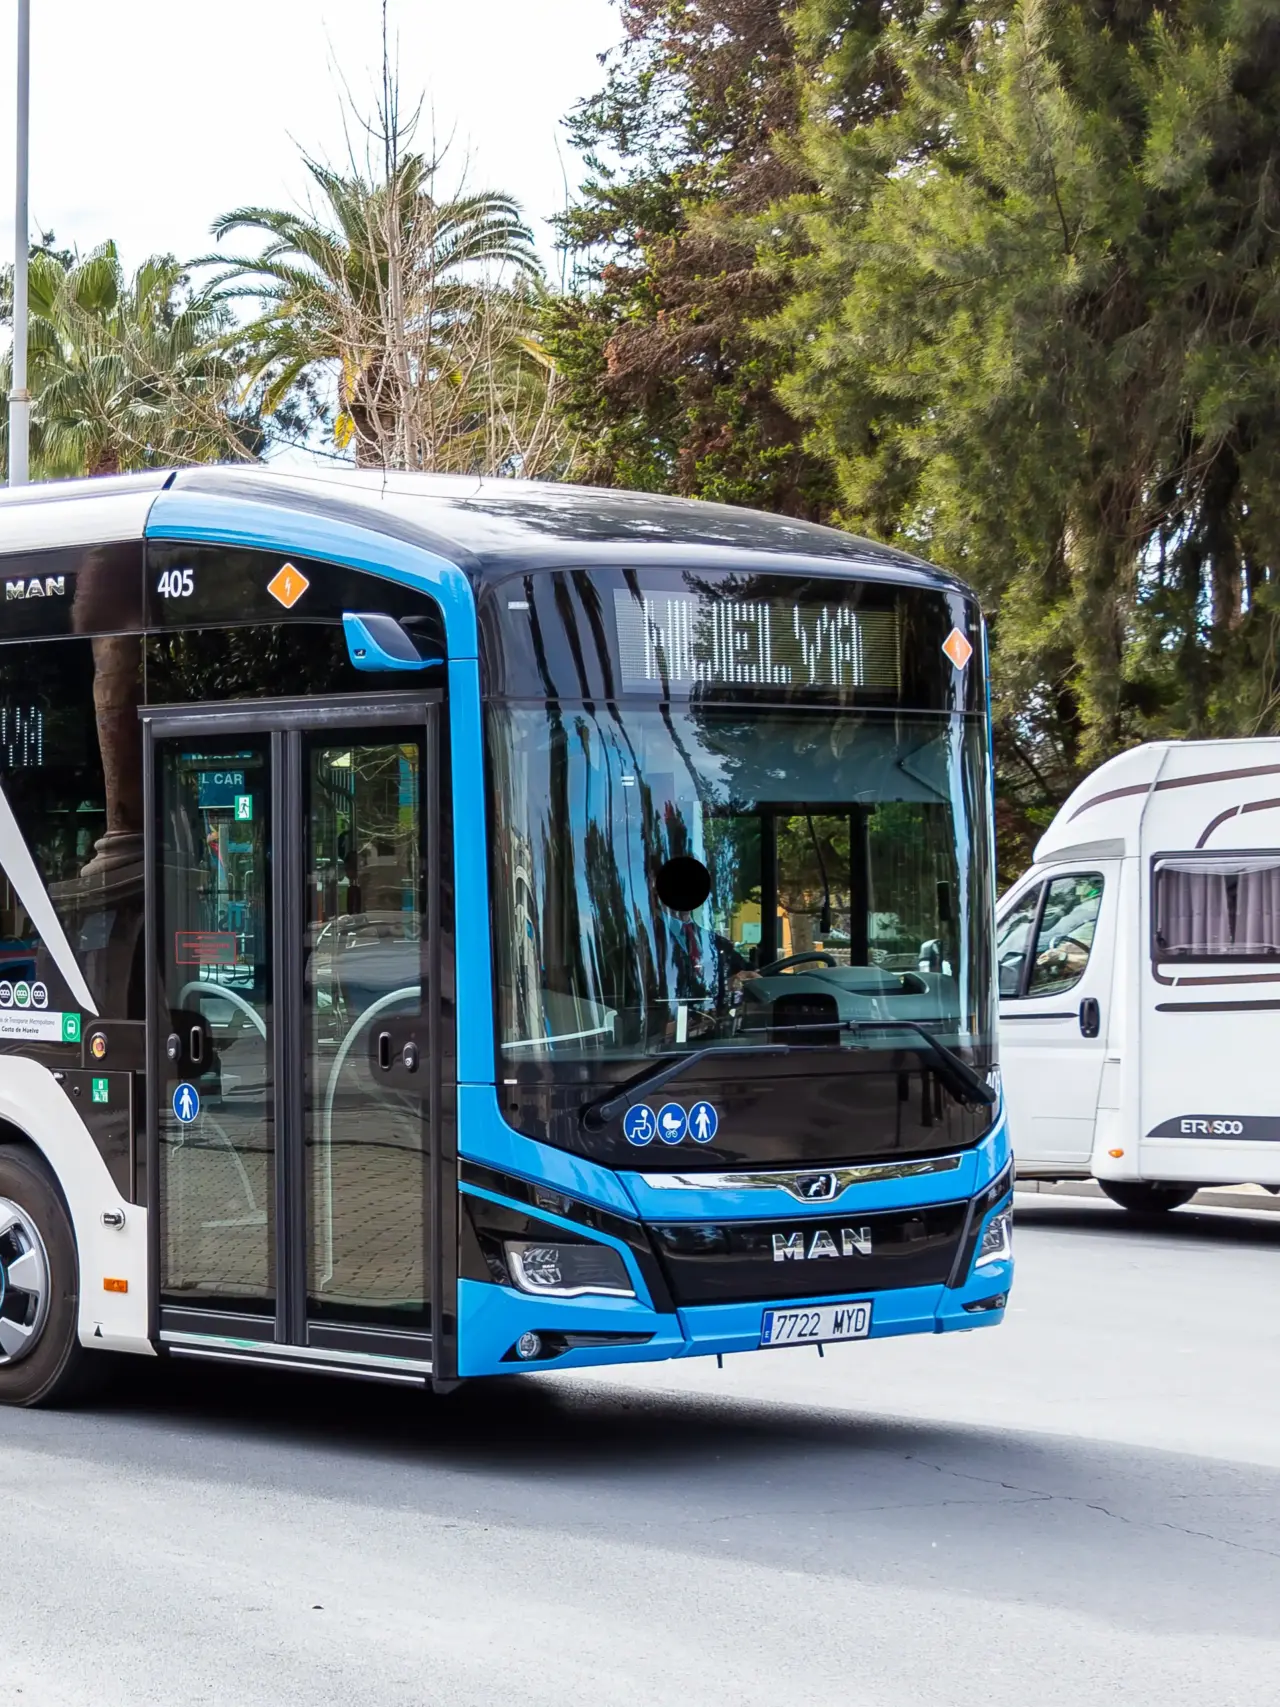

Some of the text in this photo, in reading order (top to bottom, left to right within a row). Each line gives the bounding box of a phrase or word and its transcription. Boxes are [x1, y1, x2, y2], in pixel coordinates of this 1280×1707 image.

[5, 576, 65, 601] MAN
[157, 569, 195, 599] 405
[772, 1226, 872, 1262] MAN
[774, 1312, 822, 1341] 7722
[832, 1307, 867, 1335] MYD
